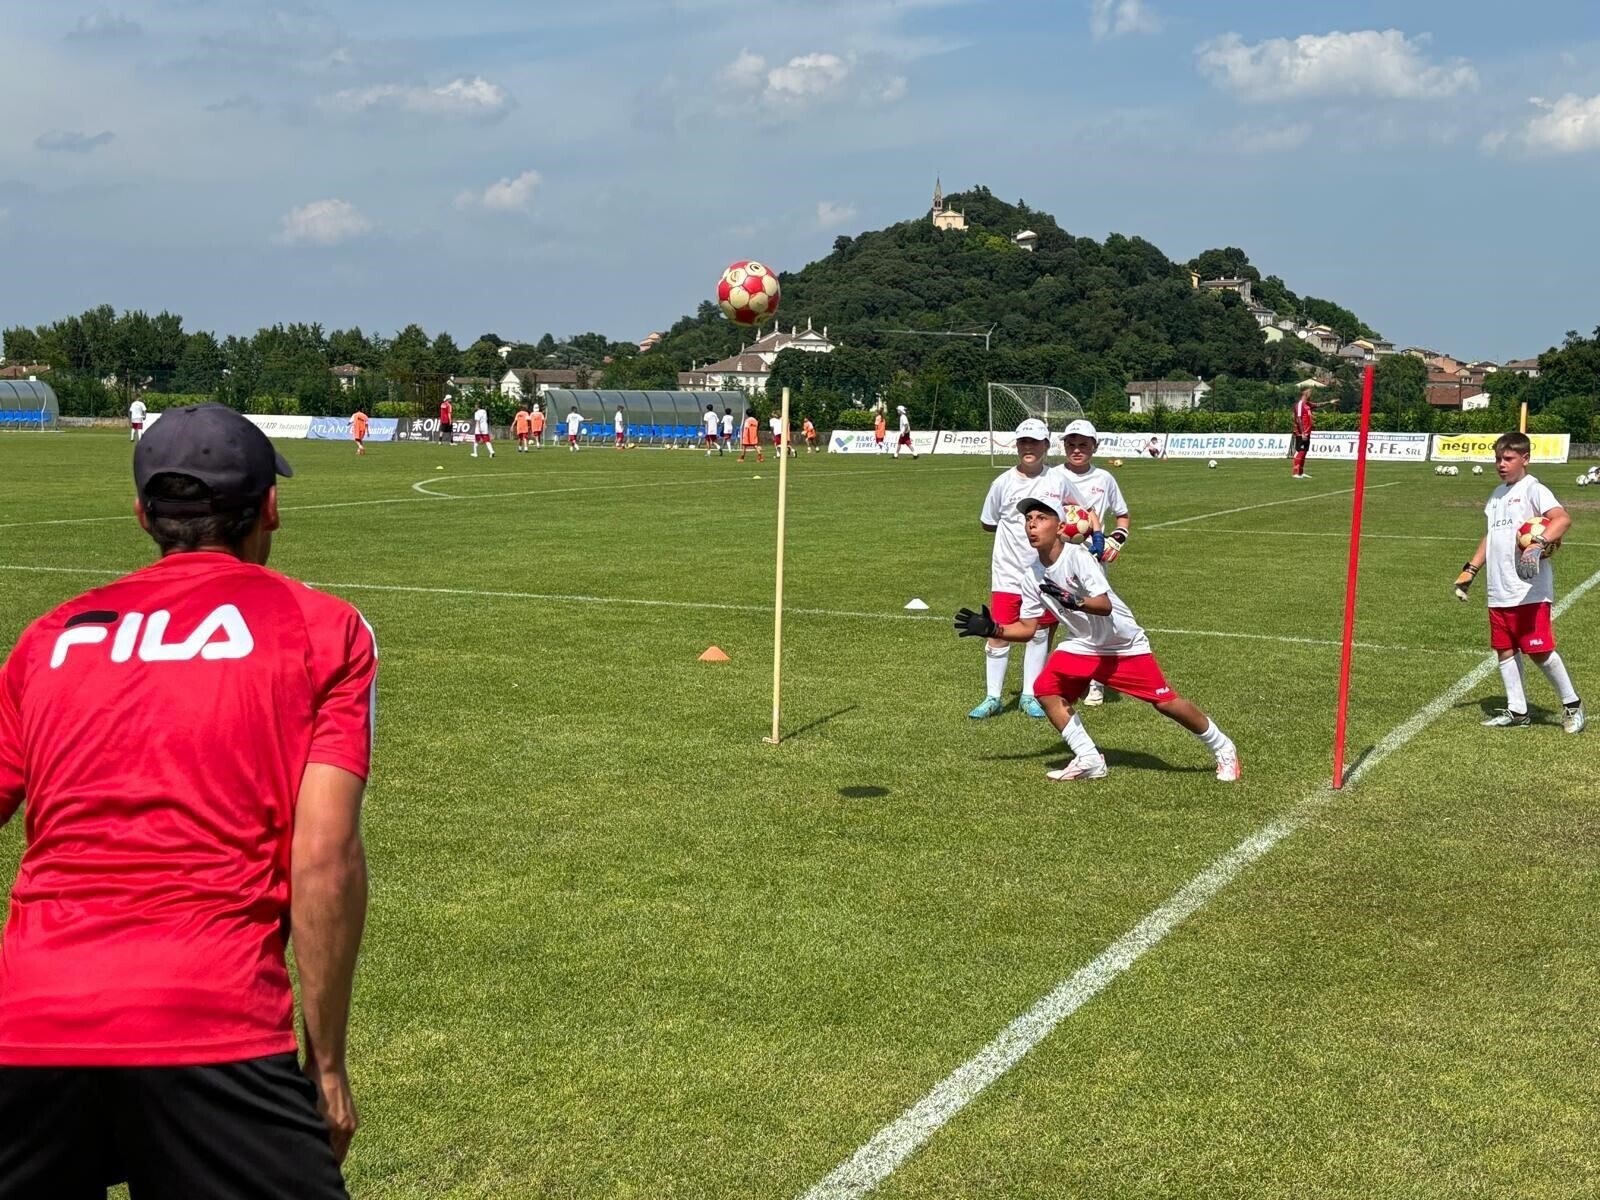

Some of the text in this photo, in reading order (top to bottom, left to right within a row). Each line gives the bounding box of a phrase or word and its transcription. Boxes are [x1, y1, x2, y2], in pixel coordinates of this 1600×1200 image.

[943, 433, 988, 444] Bi-mec
[1169, 437, 1287, 449] METALFER 2000 S.R.L.
[1311, 444, 1341, 453] UOVA
[50, 603, 255, 669] FILA
